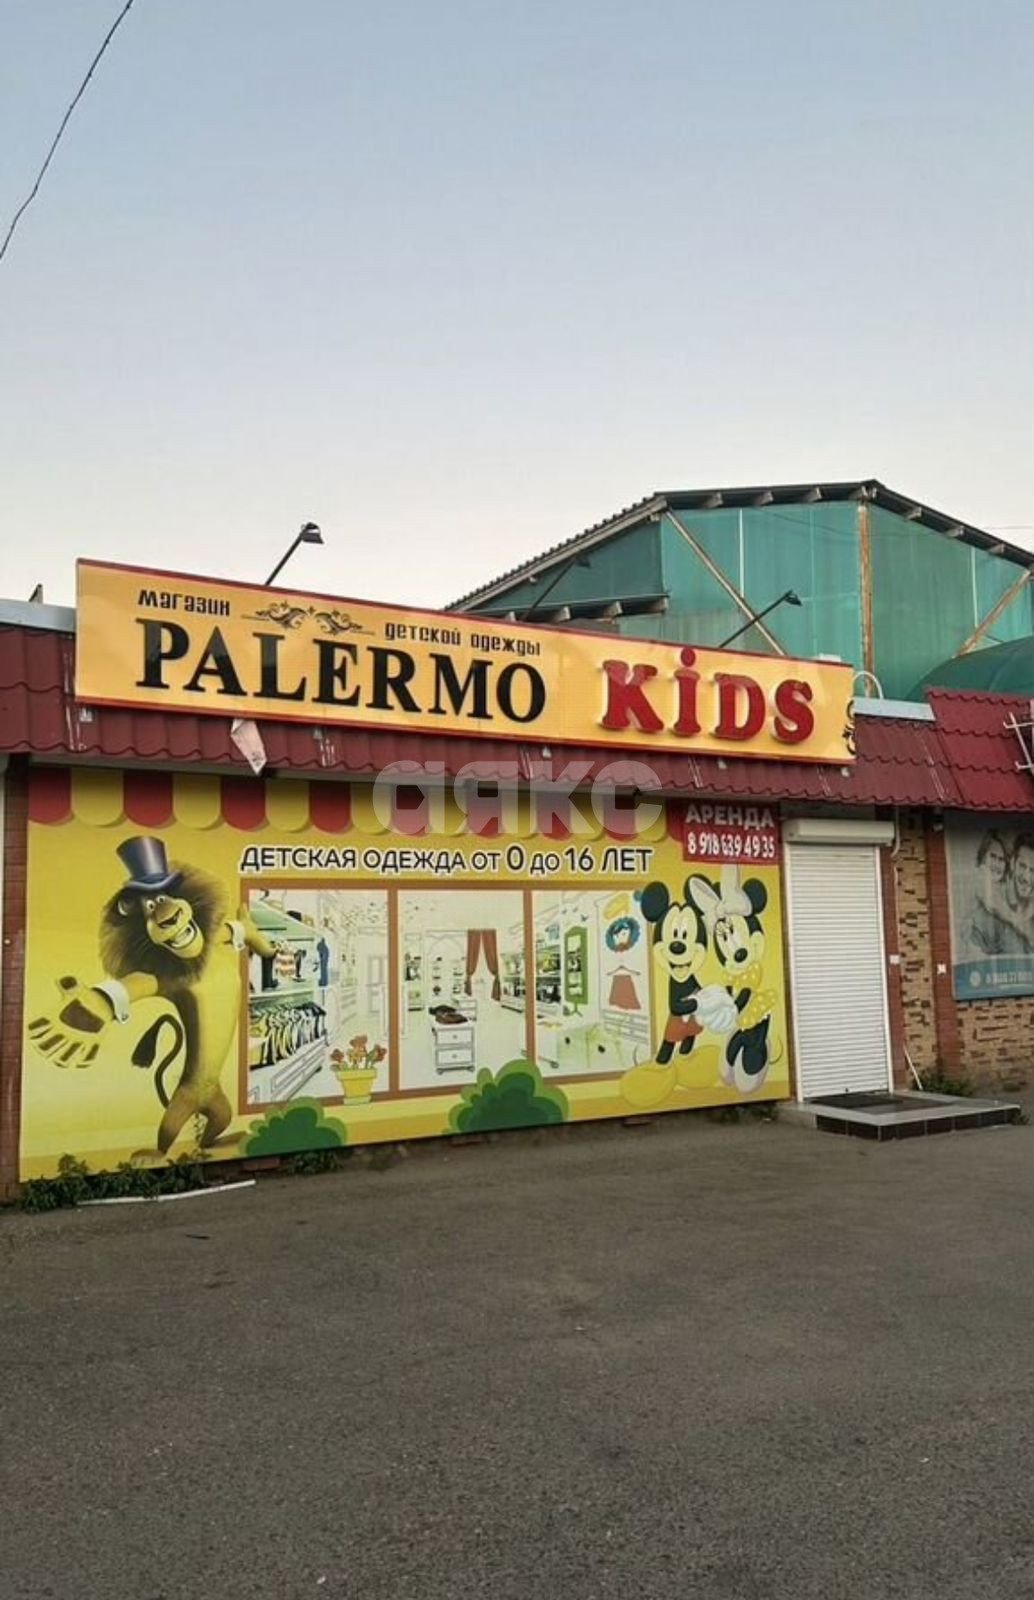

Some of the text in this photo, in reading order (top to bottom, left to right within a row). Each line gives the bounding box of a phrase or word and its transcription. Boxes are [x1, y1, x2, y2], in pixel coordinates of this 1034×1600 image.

[138, 589, 230, 616] магазин
[385, 622, 540, 656] детской одежды
[135, 618, 546, 724] PALERMO
[685, 804, 775, 831] АРЕНДА
[688, 832, 697, 855] 8
[699, 832, 720, 856] 918
[744, 835, 761, 858] 49
[240, 847, 356, 872] ДЕТСКАЯ
[363, 850, 466, 873] ОДЕЖДА
[507, 846, 524, 871] 0
[565, 847, 594, 871] 16
[602, 848, 652, 872] ЛЕТ
